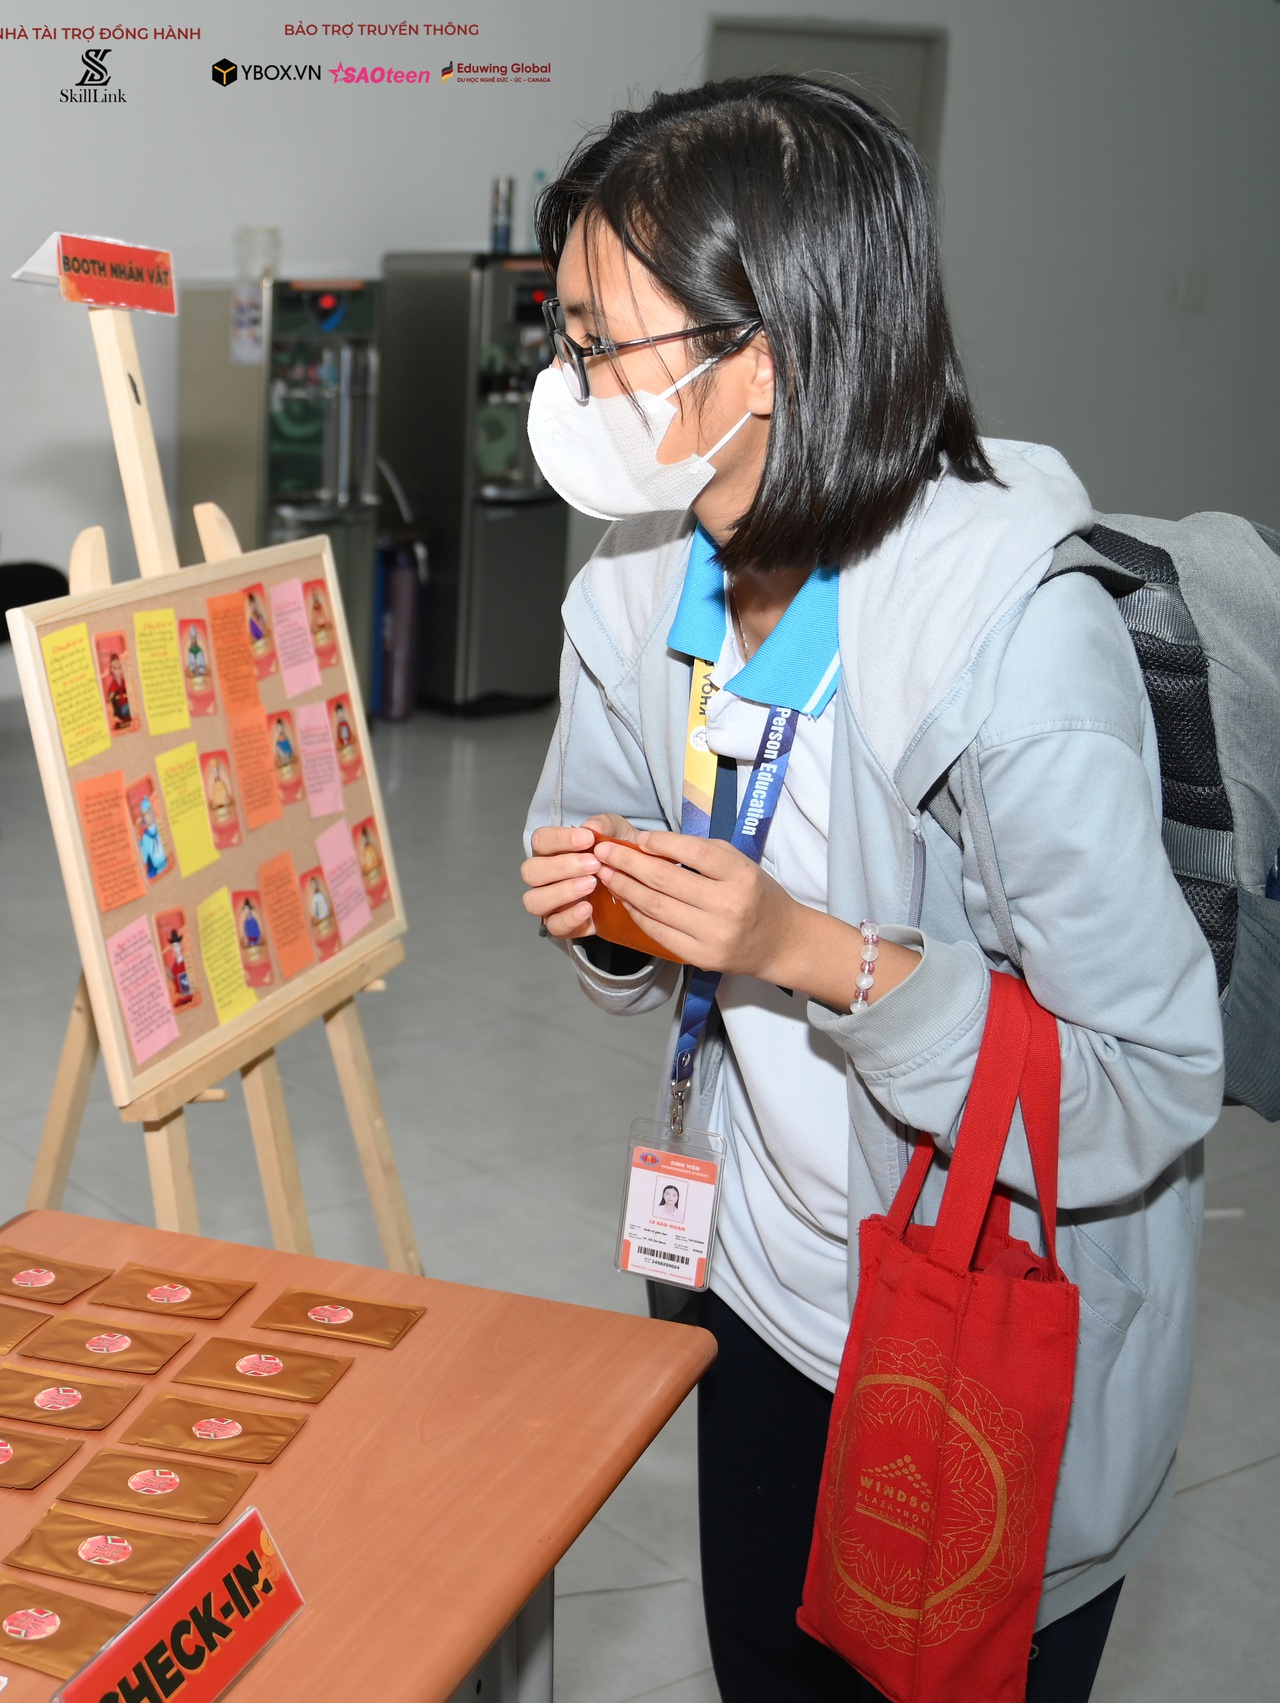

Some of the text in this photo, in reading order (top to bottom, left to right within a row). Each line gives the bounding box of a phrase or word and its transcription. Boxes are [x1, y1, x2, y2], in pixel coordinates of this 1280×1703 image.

[62, 255, 108, 277] BOOTH
[109, 262, 145, 284] NHÂN
[742, 708, 792, 836] Person Education
[856, 1490, 893, 1513] PLAZA
[98, 1549, 273, 1703] HECK-IN
